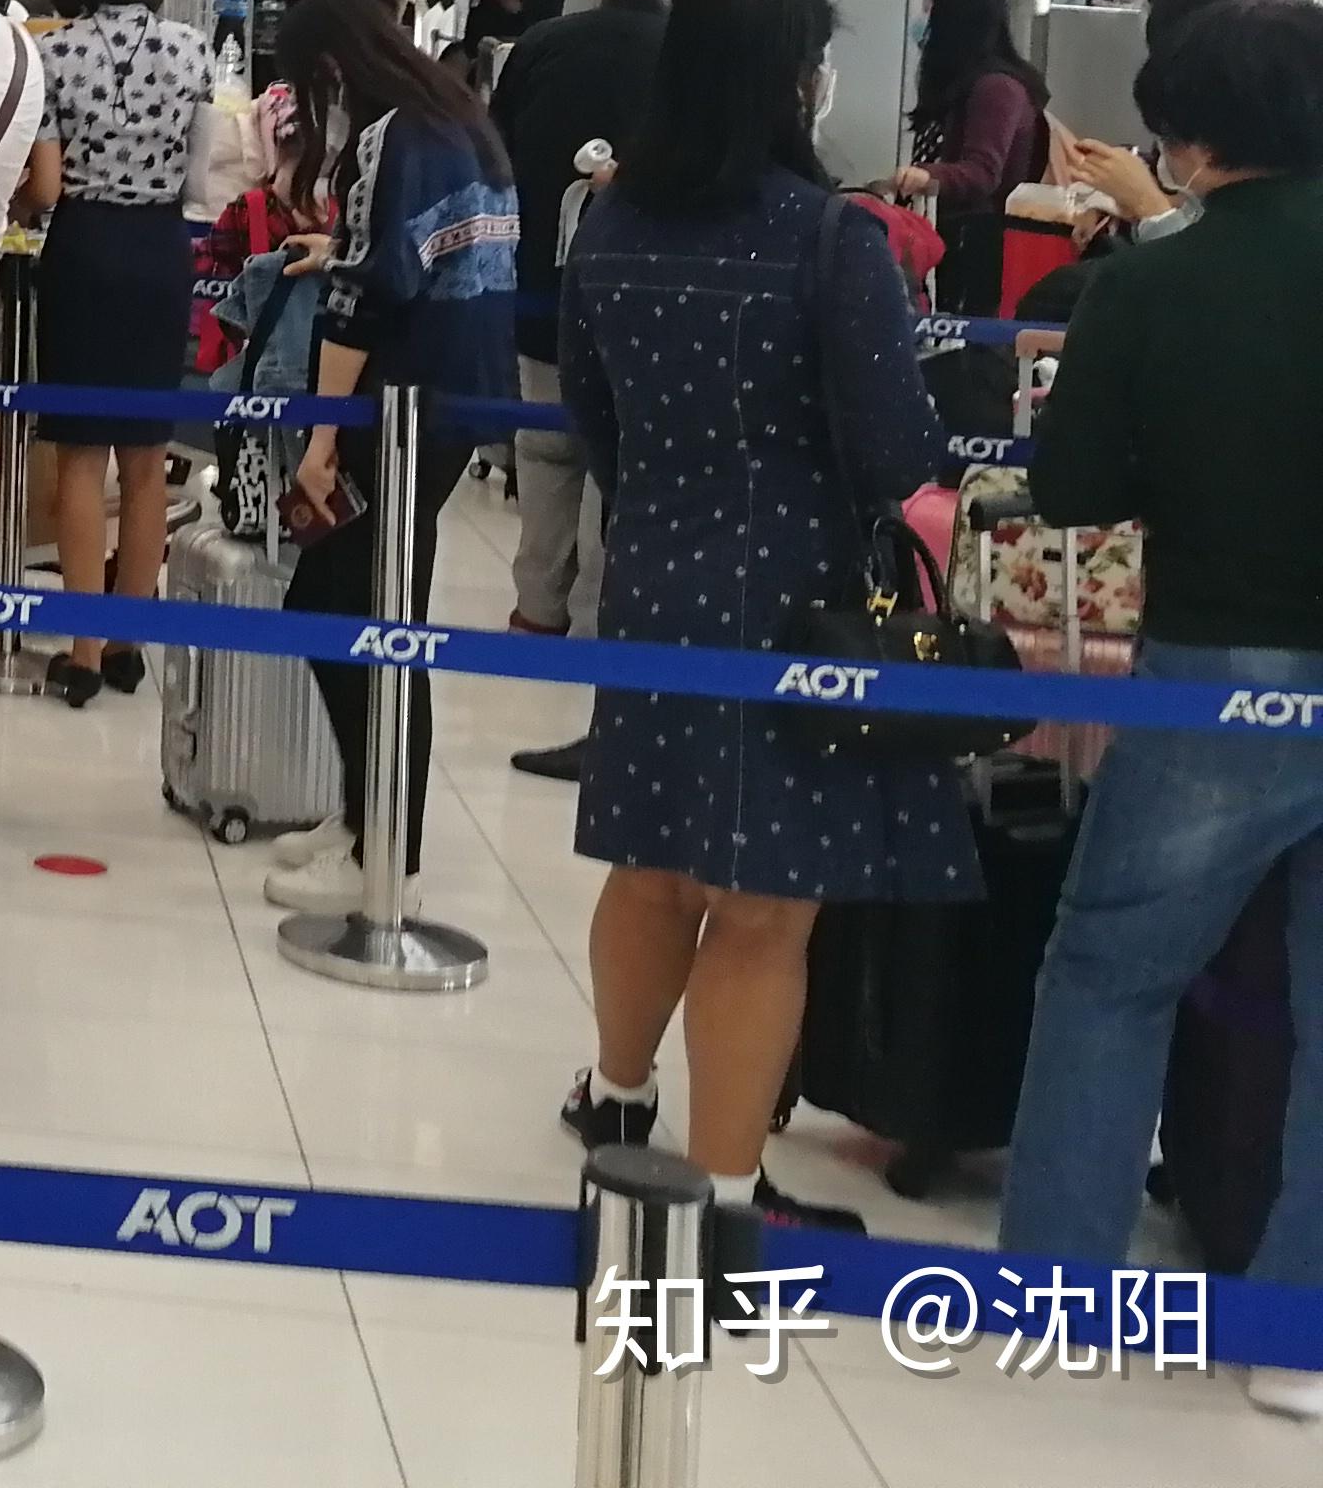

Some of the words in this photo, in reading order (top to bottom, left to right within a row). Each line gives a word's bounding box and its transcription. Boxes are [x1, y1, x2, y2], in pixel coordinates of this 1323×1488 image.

[914, 317, 971, 337] AOT
[224, 395, 290, 419] AOT
[947, 435, 1014, 461] AOT
[349, 625, 450, 664] AOT
[774, 662, 879, 700] AOT
[1219, 690, 1323, 727] AOT
[116, 1188, 296, 1253] AOT
